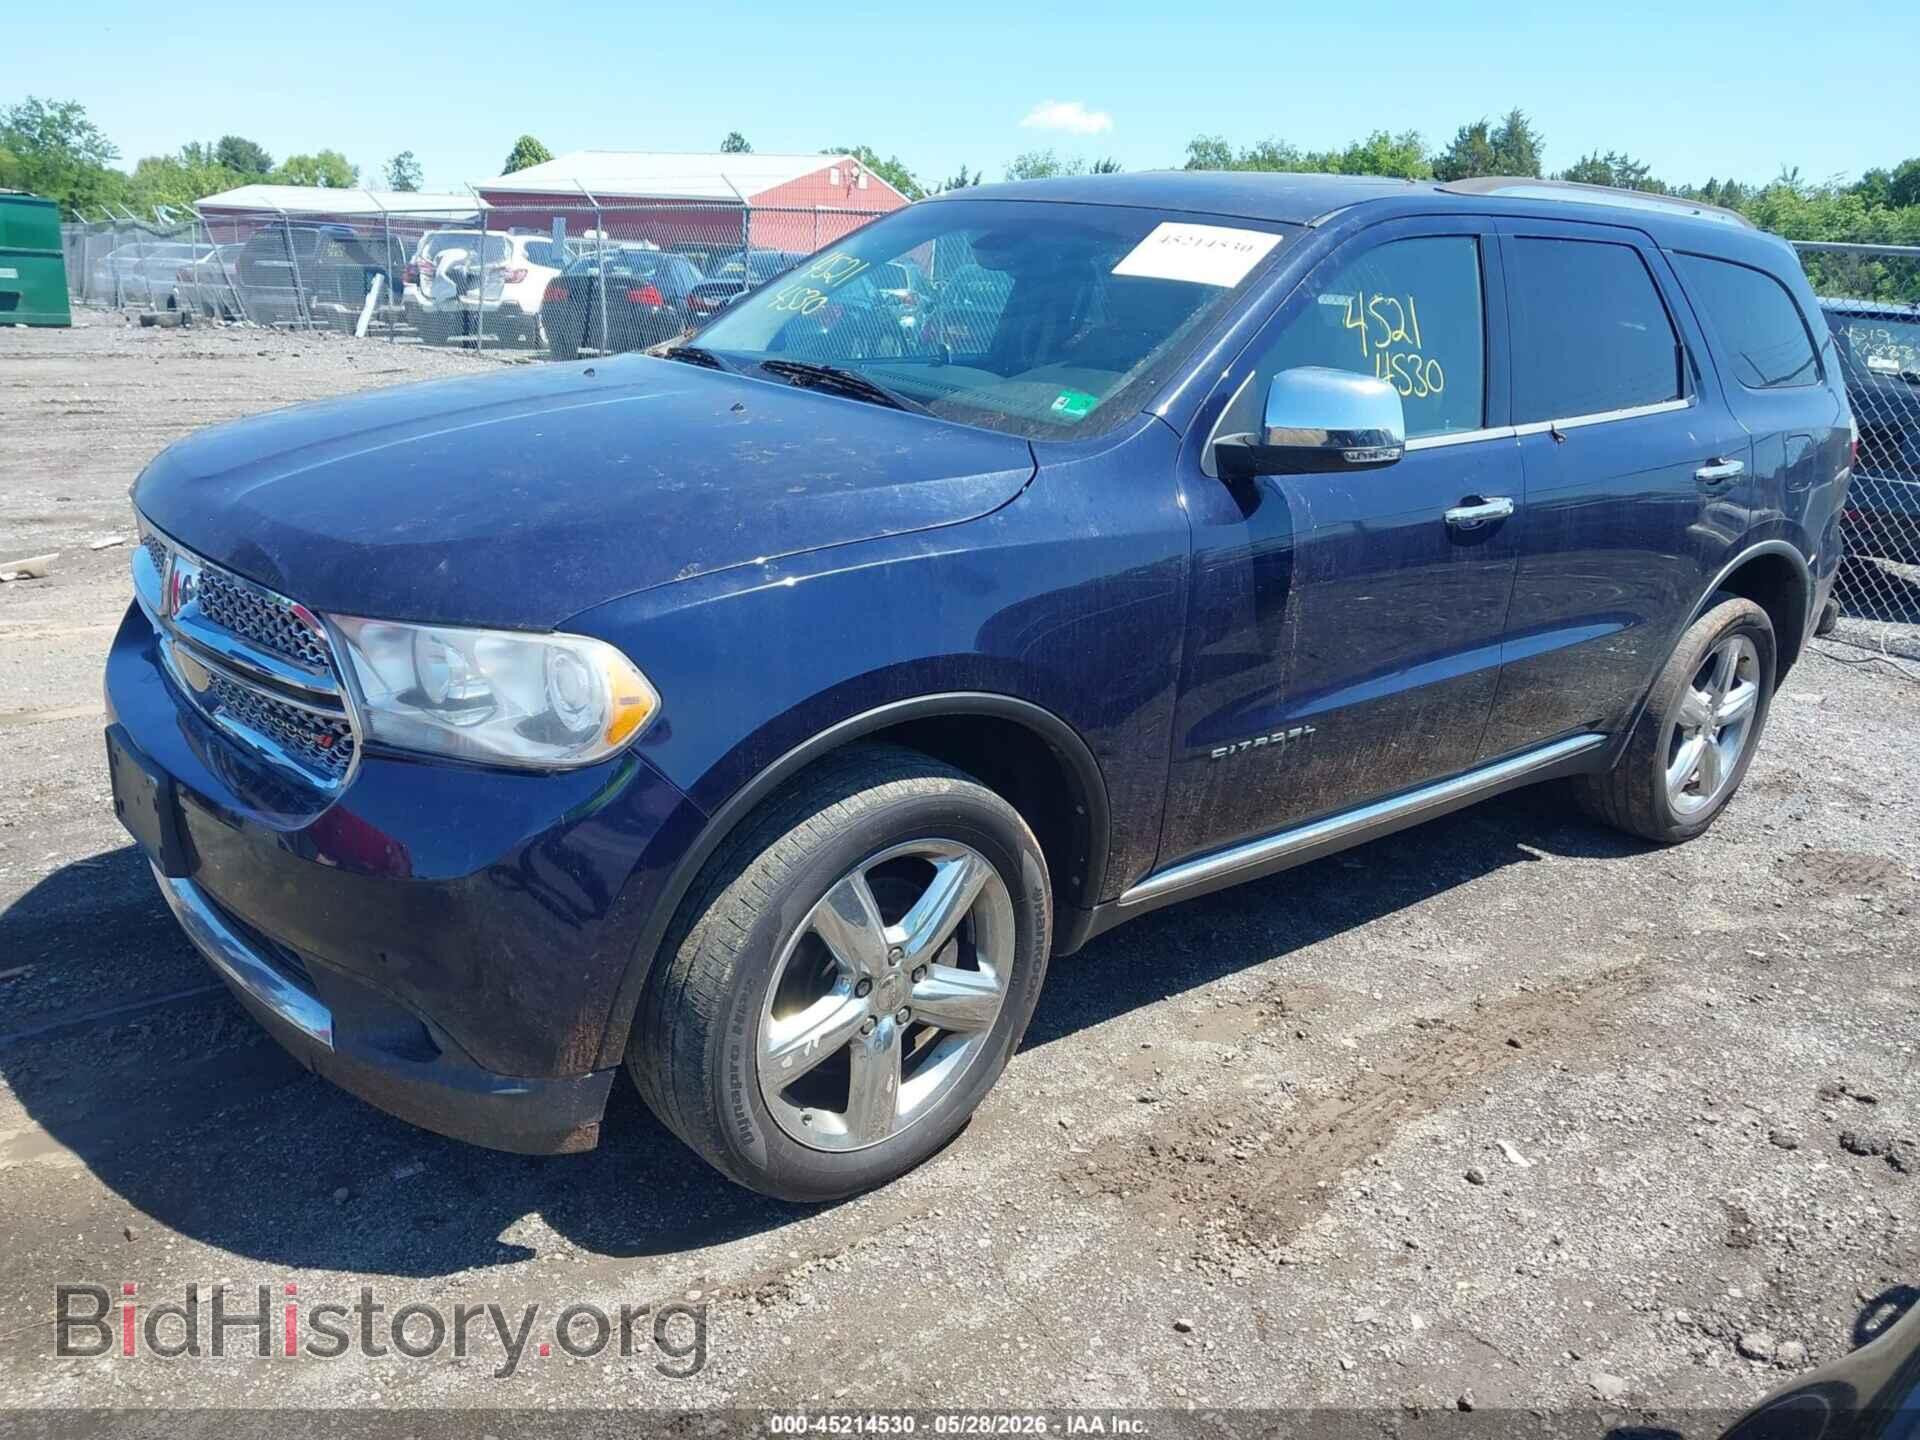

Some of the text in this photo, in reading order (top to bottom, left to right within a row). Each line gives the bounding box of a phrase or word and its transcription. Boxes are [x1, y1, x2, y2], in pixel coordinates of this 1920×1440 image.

[802, 251, 870, 287] 4521
[1345, 291, 1422, 357] 4521
[1376, 352, 1444, 397] 4530
